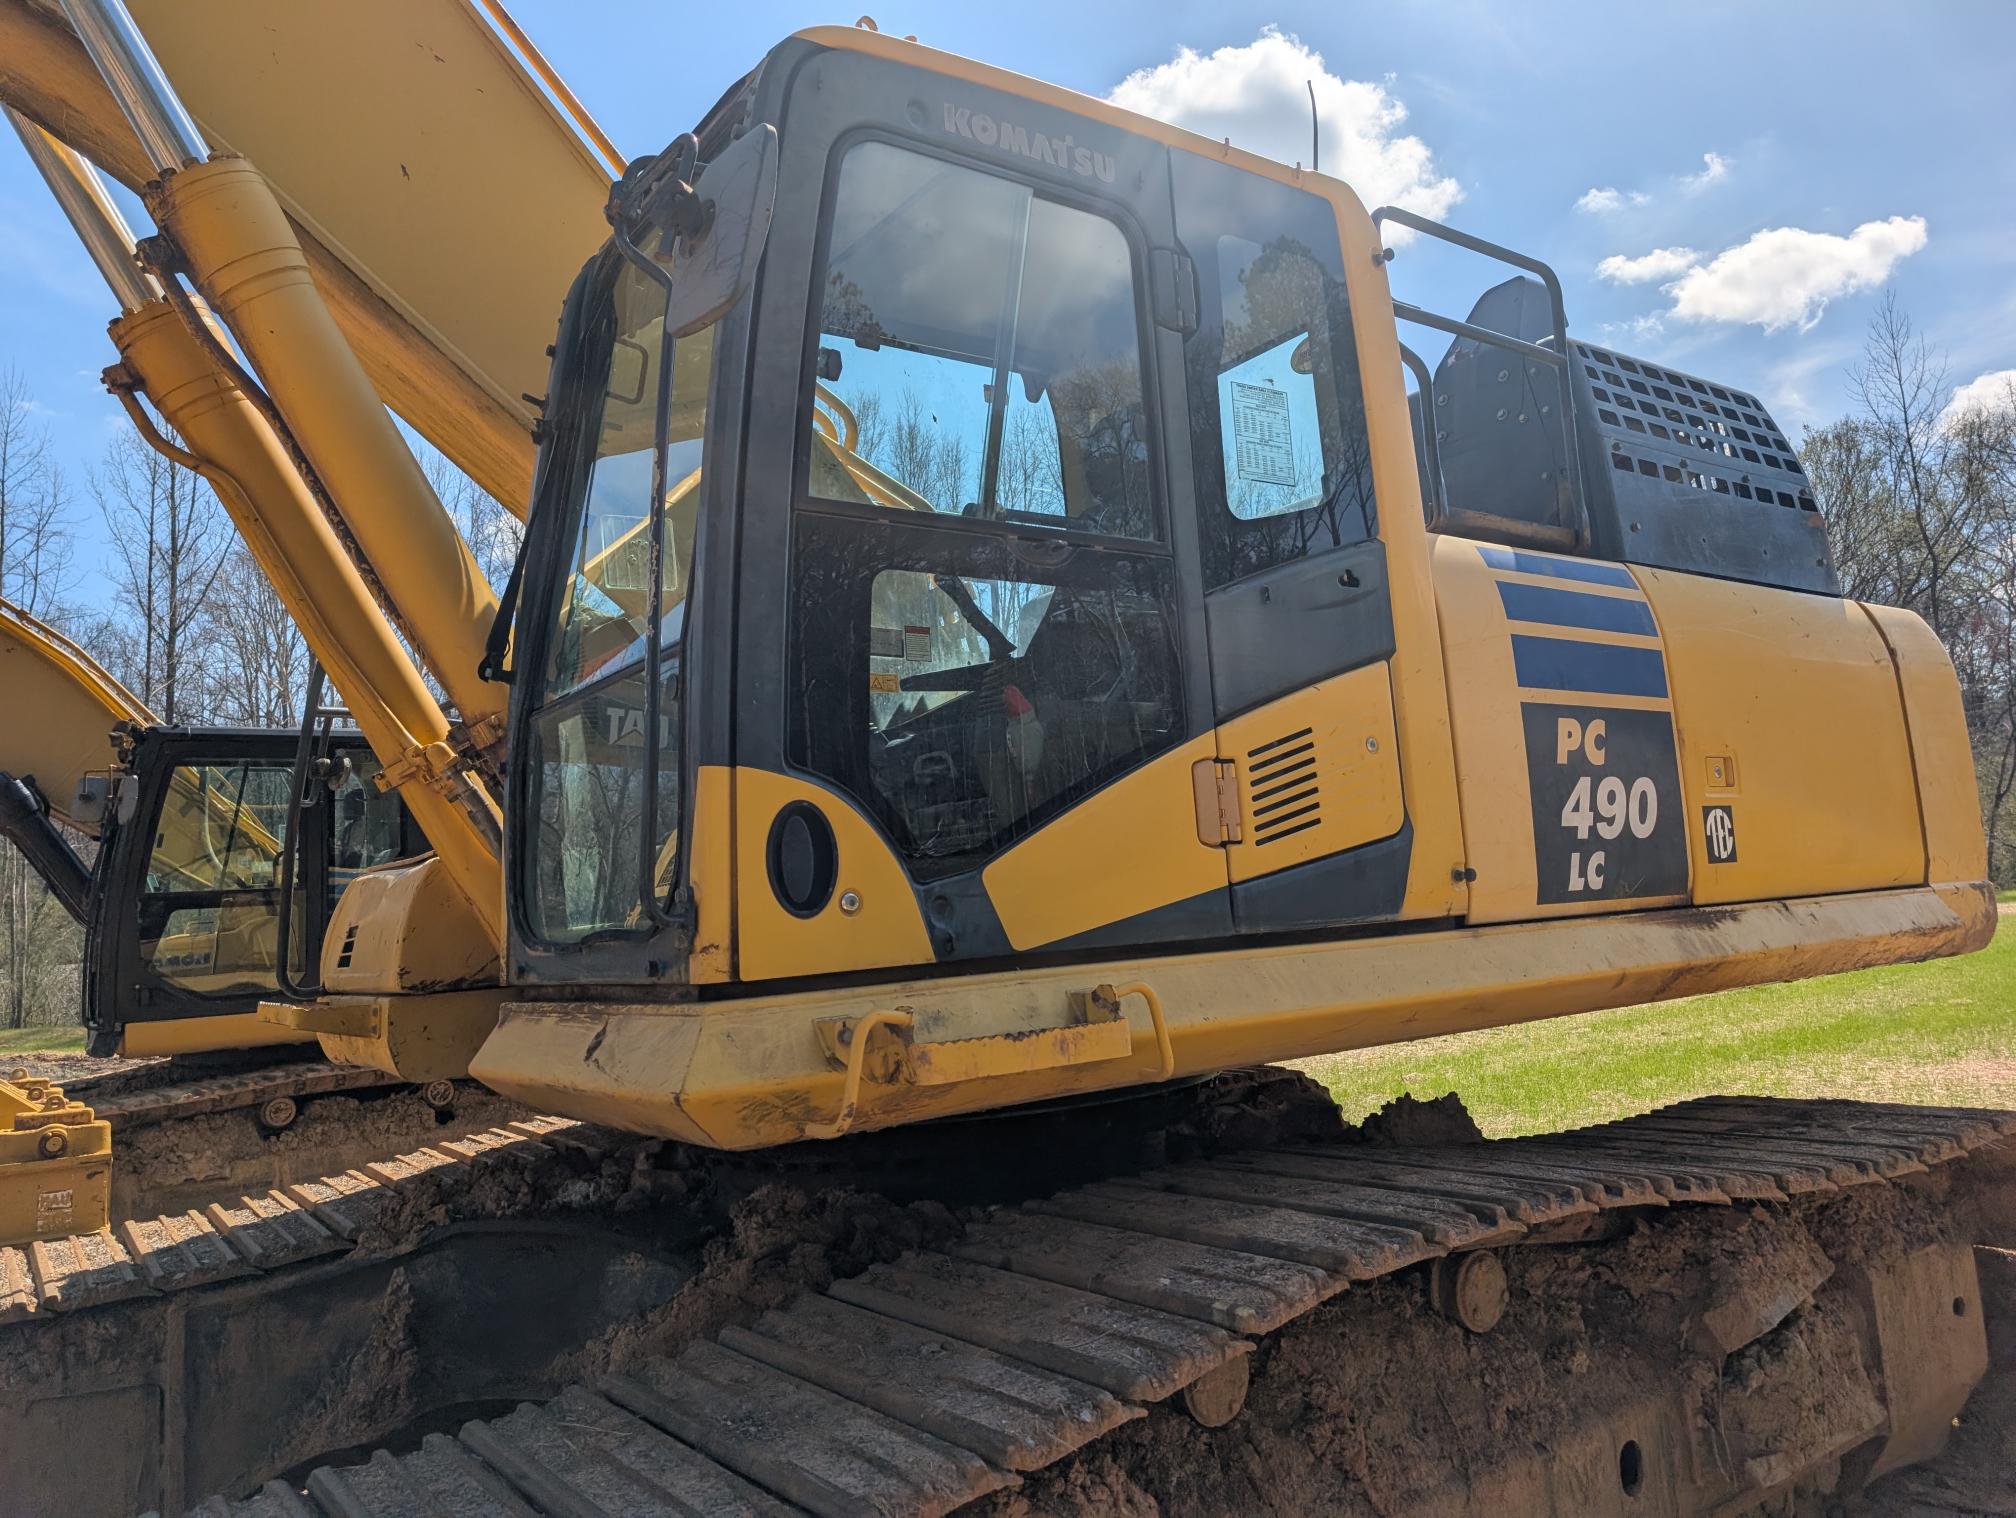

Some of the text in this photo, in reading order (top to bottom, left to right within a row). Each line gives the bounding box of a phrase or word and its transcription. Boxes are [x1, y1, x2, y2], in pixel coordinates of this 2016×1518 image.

[943, 103, 1115, 183] KOMATSU
[1556, 717, 1606, 766] PC
[1561, 776, 1658, 840] 490
[1568, 851, 1606, 892] LC
